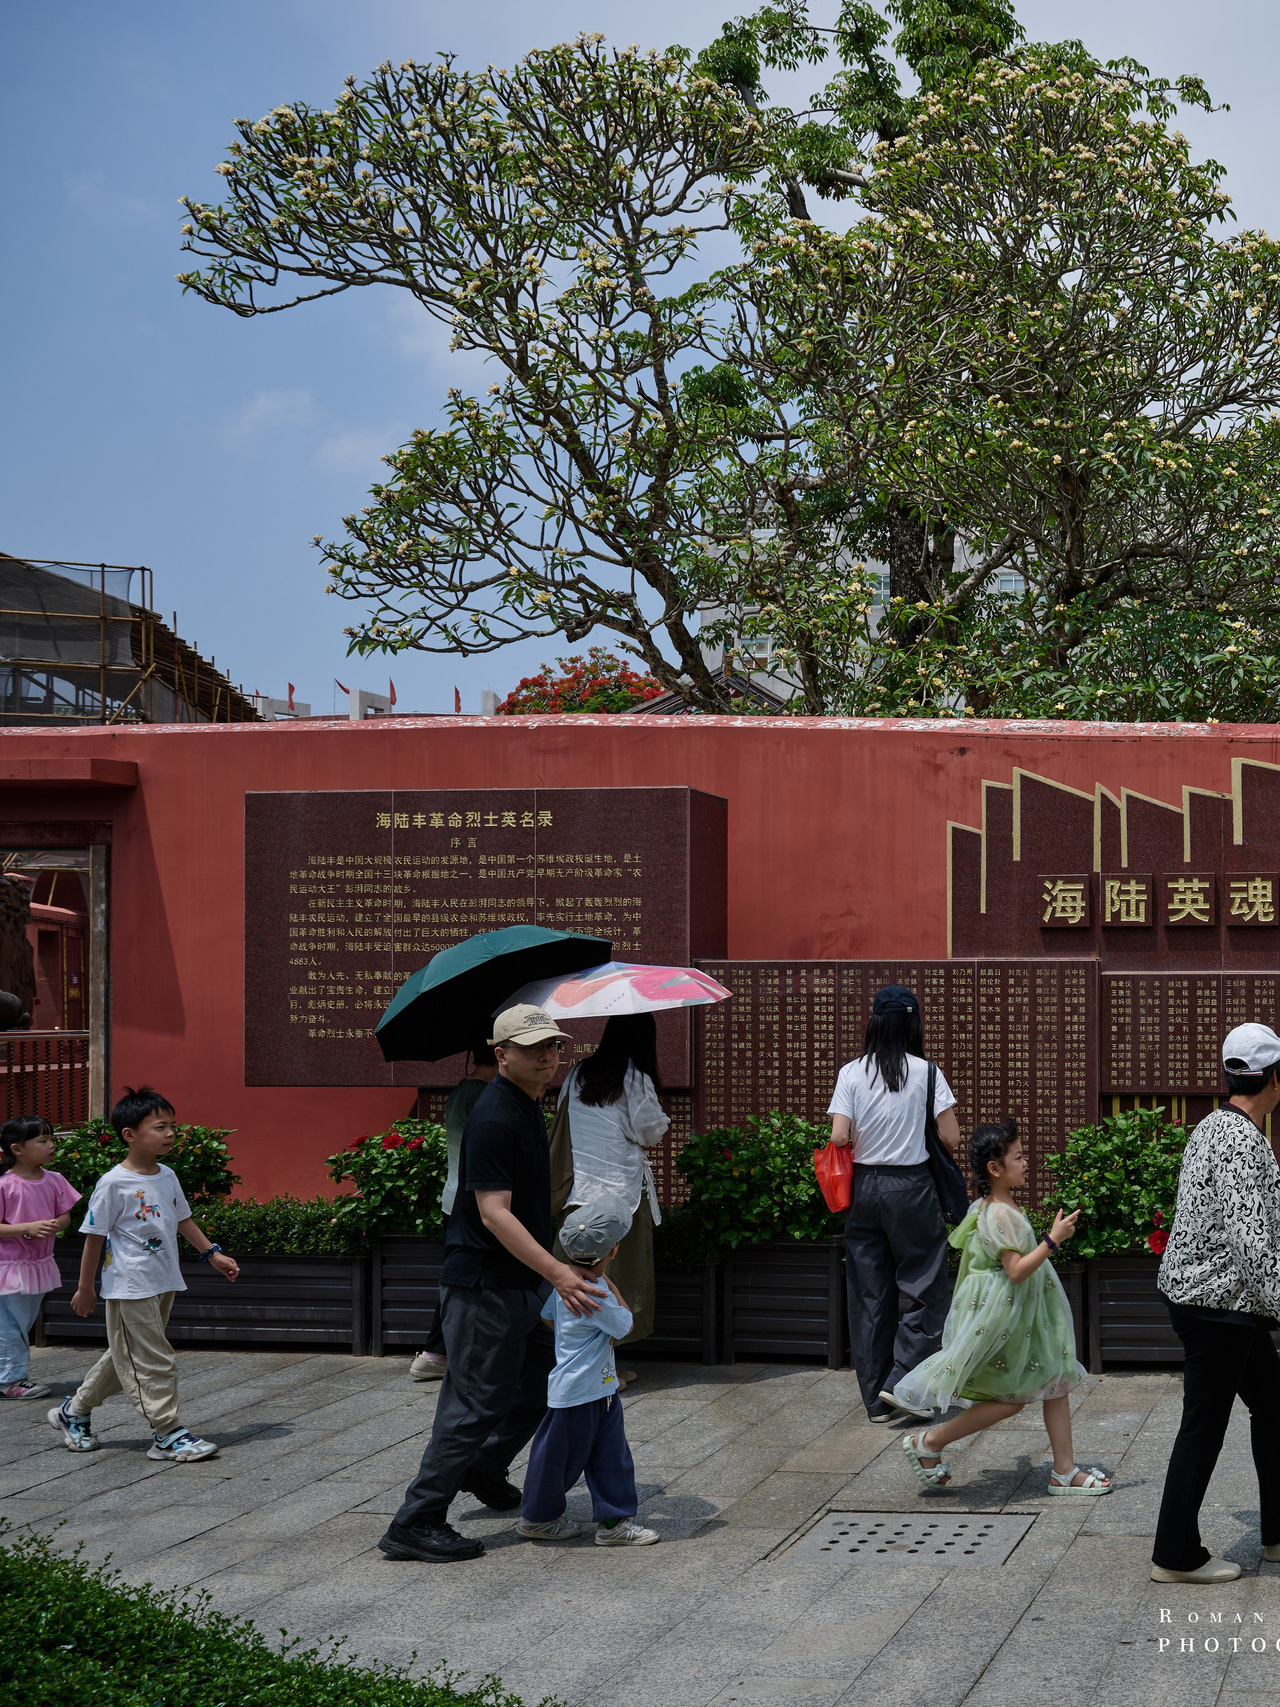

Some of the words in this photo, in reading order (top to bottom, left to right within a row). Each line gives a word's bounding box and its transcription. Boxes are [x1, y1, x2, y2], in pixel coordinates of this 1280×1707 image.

[375, 810, 554, 830] 海陆丰革命烈士英名录
[1041, 877, 1276, 926] 海陆英魂
[308, 1028, 377, 1040] 革命烈士永垂不
